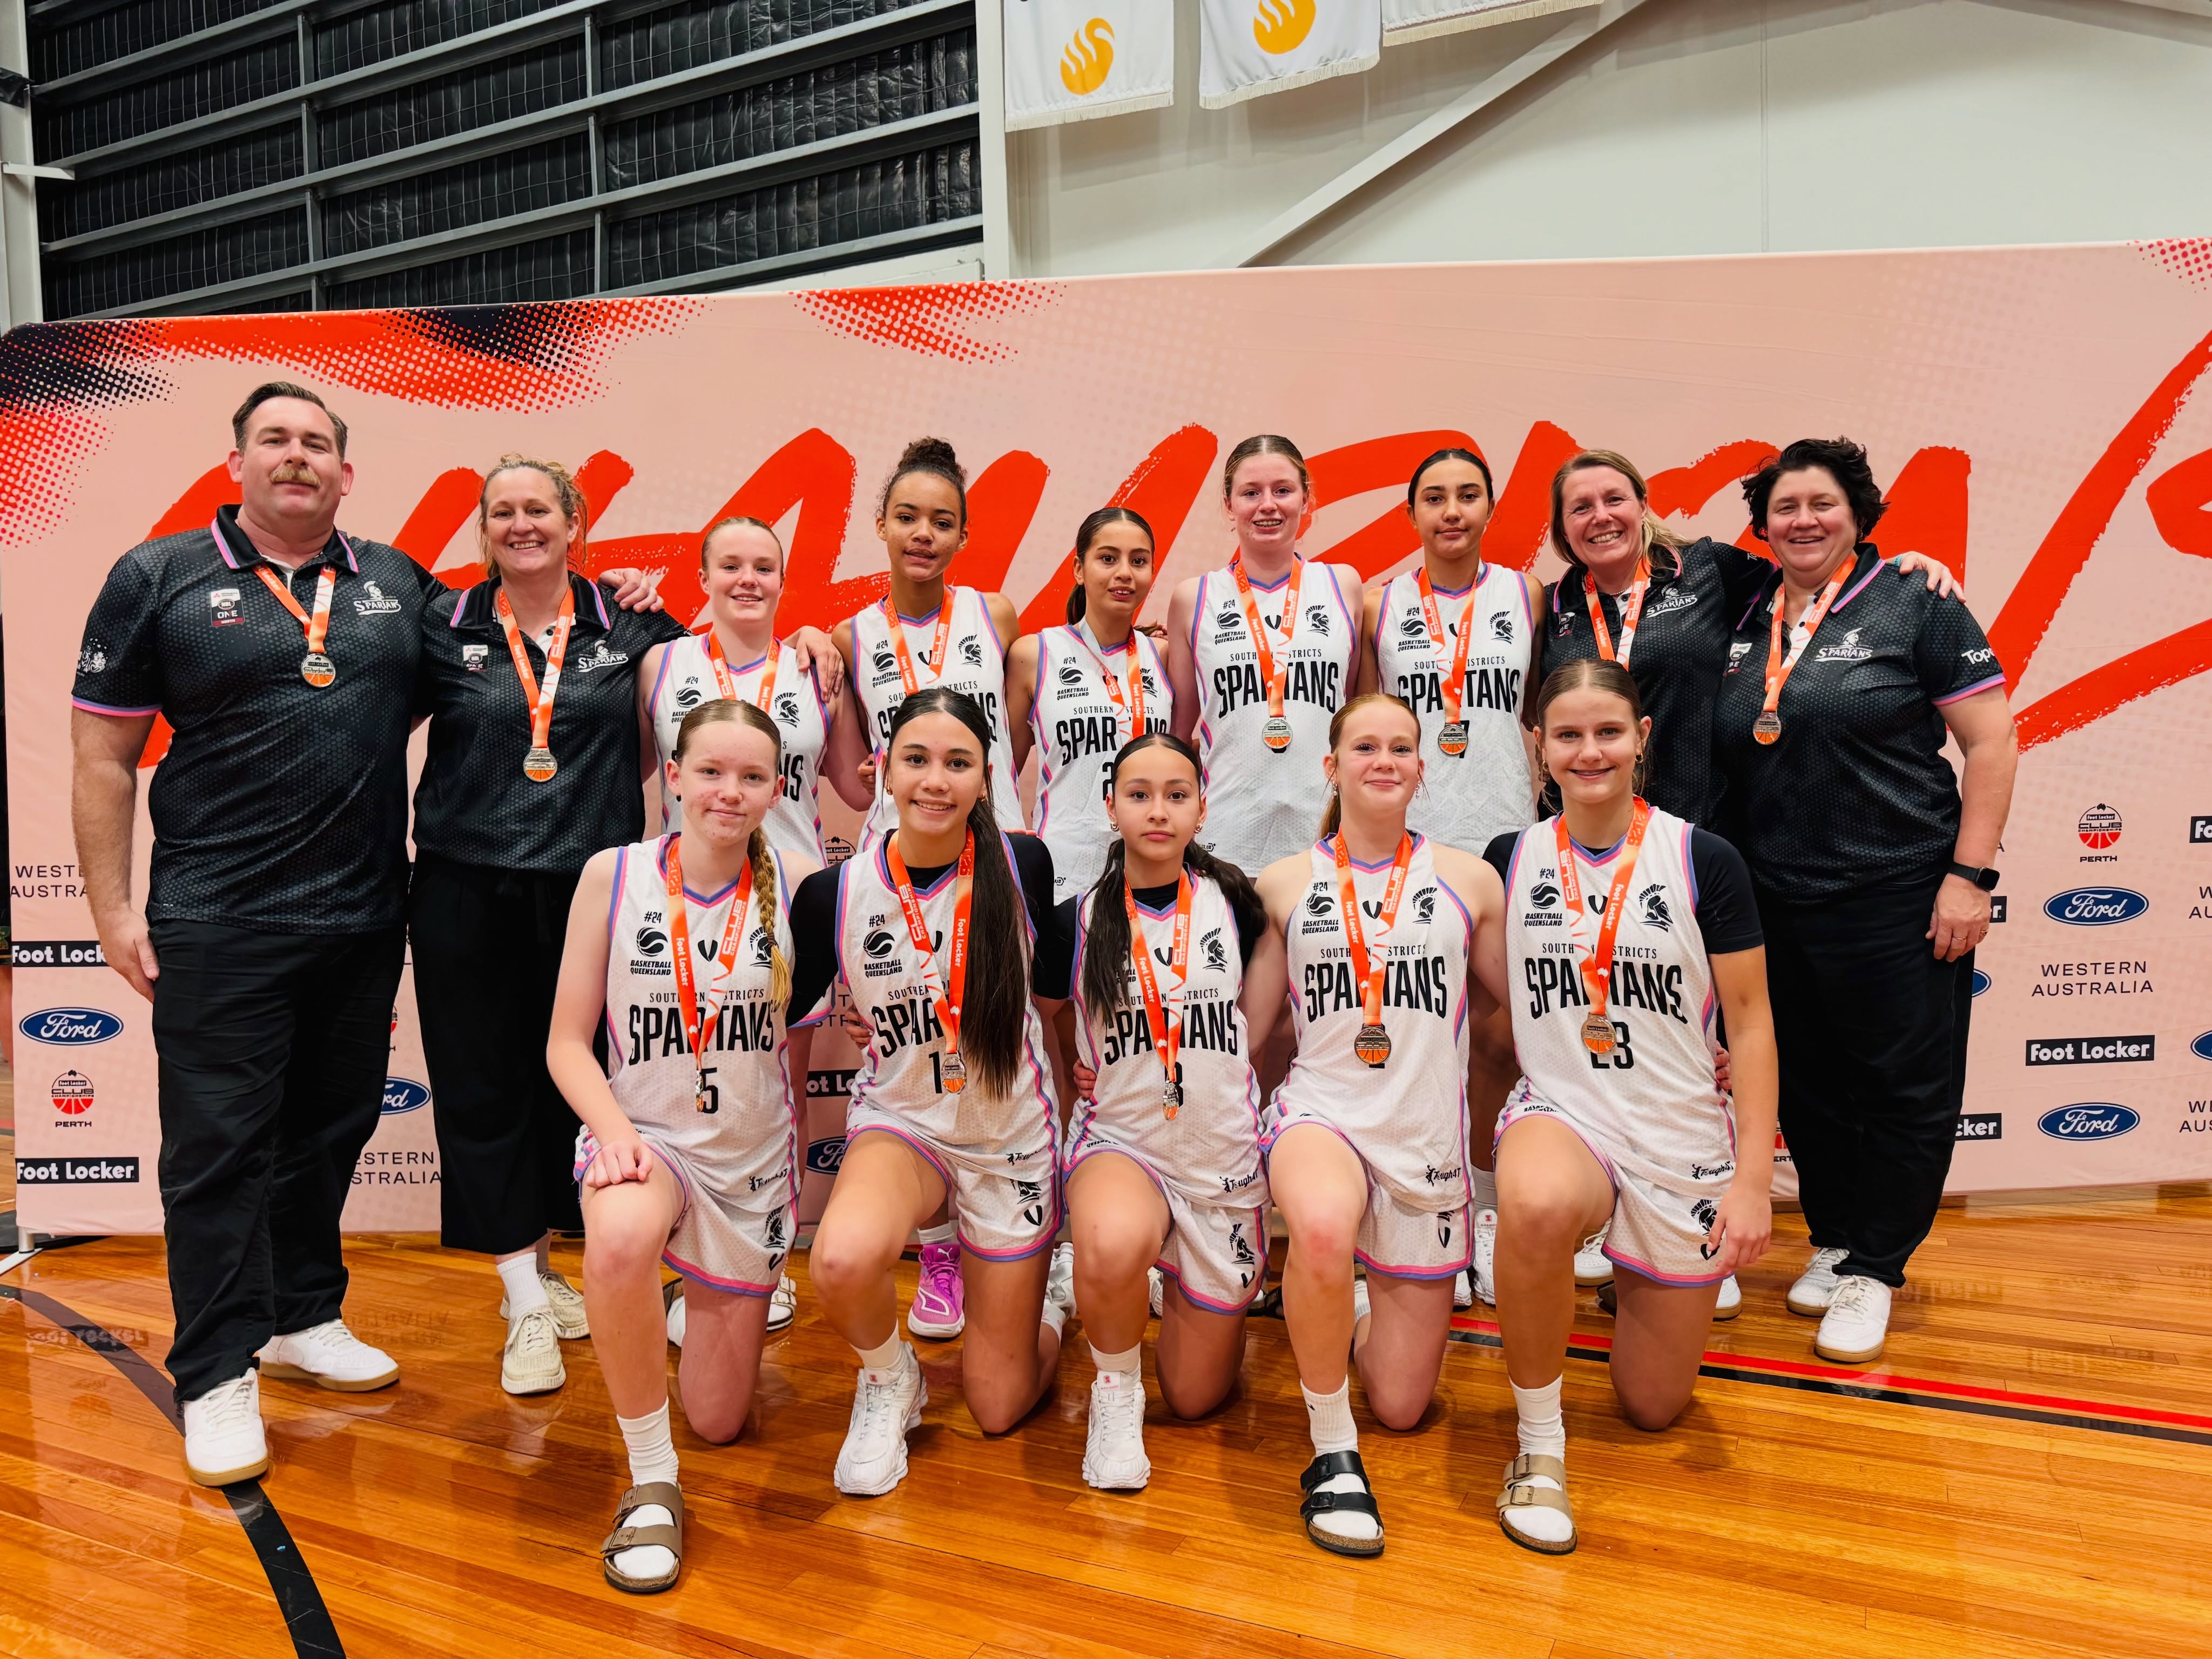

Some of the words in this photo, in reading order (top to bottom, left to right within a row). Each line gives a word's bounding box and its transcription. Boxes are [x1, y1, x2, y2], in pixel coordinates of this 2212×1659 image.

[1223, 599, 1236, 610] #24
[1283, 589, 1296, 628] CLUB
[1627, 581, 1641, 621] CLUB
[1809, 581, 1837, 623] CLUB
[1406, 606, 1420, 617] #24
[1422, 596, 1439, 636] CLUB
[551, 616, 567, 658] CLUB
[1215, 630, 1246, 639] BASKETBALL
[1251, 618, 1259, 632] Foot
[1255, 631, 1266, 652] Locker
[1461, 621, 1469, 636] Foot
[876, 639, 888, 650] #24
[932, 623, 945, 665] CLUB
[1215, 635, 1246, 645] QUEENSLAND
[1398, 639, 1430, 647] BASKETBALL
[1398, 644, 1431, 652] QUEENSLAND
[1457, 635, 1467, 658] Locker
[1289, 649, 1322, 659] STRICTS
[1467, 656, 1506, 667] ISTRICTS
[713, 658, 731, 696] CLUB
[945, 680, 978, 692] TRICTS
[1056, 692, 1089, 701] QUEENSLAND
[1057, 687, 1089, 695] BASKETBALL
[1213, 661, 1339, 719] SPATANS
[1398, 667, 1520, 717] SPATANS
[1074, 706, 1114, 715] SOUTHERN
[2195, 820, 2212, 838] Fo
[1539, 868, 1555, 879] #24
[1559, 849, 1575, 902] CLUB
[1566, 848, 1579, 901] CHAMPIONSHIPS
[1313, 882, 1328, 892] #24
[1382, 866, 1401, 914] CLUB
[1391, 867, 1406, 914] CHAMPIONSHIPS
[1614, 884, 1624, 901] Foot
[899, 885, 922, 942] CLUB
[906, 882, 926, 940] CHAMPIONSHIPS
[1345, 900, 1354, 917] Foot
[2065, 893, 2128, 919] Ford
[644, 911, 662, 923] #24
[868, 914, 886, 928] #24
[1524, 919, 1562, 928] QUEENSLAND
[1604, 901, 1619, 930] Locker
[722, 899, 744, 955] CLUB
[730, 901, 747, 956] CHAMPIONSHIPS
[957, 919, 966, 938] Foot
[1301, 925, 1339, 935] QUEENSLAND
[1349, 917, 1359, 944] Locker
[676, 936, 686, 956] Foot
[1174, 913, 1185, 965] CLUB
[1181, 914, 1189, 966] CHAMPIONSHIPS
[12, 945, 54, 963] Foot
[954, 938, 963, 967] Locker
[1321, 947, 1371, 959] SOUTHN
[1388, 945, 1426, 956] STRICTS
[1612, 945, 1657, 959] STRICTS
[630, 960, 672, 968] BASKETBALL
[630, 967, 671, 976] QUEENSLAND
[680, 956, 689, 987] Locker
[864, 959, 902, 970] BASKETBALL
[865, 966, 902, 979] QUEENSLAND
[2041, 961, 2147, 977] WESTERN
[1138, 957, 1148, 973] Foot
[1143, 973, 1155, 1003] Locker
[2031, 980, 2154, 997] AUSTRALIA
[650, 992, 705, 1003] SOUTRN
[724, 988, 765, 1001] STRICTS
[888, 984, 929, 1001] SOUTHE
[1184, 987, 1218, 1001] STRICTS
[41, 1013, 103, 1038] Ford
[871, 999, 945, 1058] SPAR
[2031, 1043, 2075, 1062] Foot
[2081, 1040, 2150, 1060] Locker
[807, 1074, 830, 1092] ot
[2058, 1109, 2120, 1135] Ford
[17, 1162, 59, 1180] Foot
[66, 1161, 134, 1179] Locker
[352, 1171, 442, 1184] STRALIA
